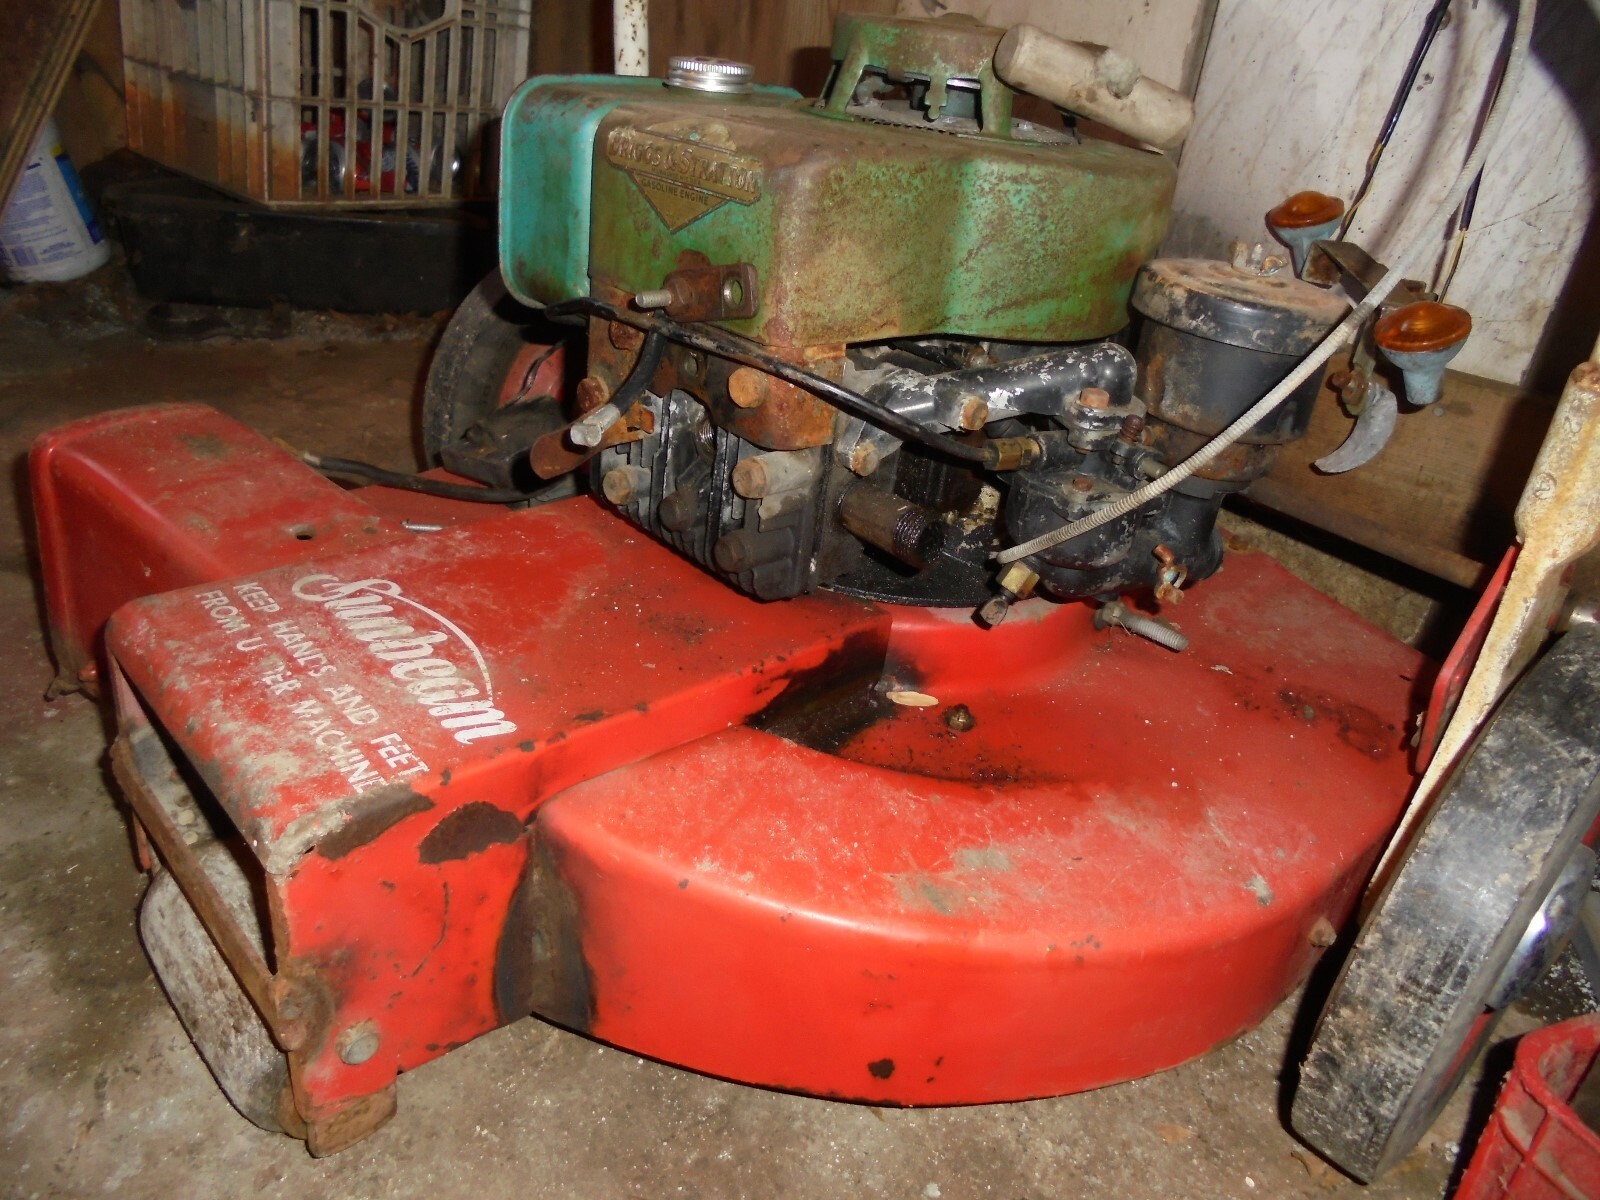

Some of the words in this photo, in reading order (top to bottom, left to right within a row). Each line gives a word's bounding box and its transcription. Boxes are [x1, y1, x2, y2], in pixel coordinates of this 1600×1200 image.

[663, 150, 678, 172] &
[641, 178, 678, 198] GASOLINE
[680, 188, 709, 206] ENGINE
[195, 589, 251, 634] FROM
[233, 582, 281, 613] KEEP
[267, 620, 337, 677] HANDS
[323, 684, 380, 725] AND
[370, 733, 430, 777] FEET
[291, 574, 517, 744] Sunbeam
